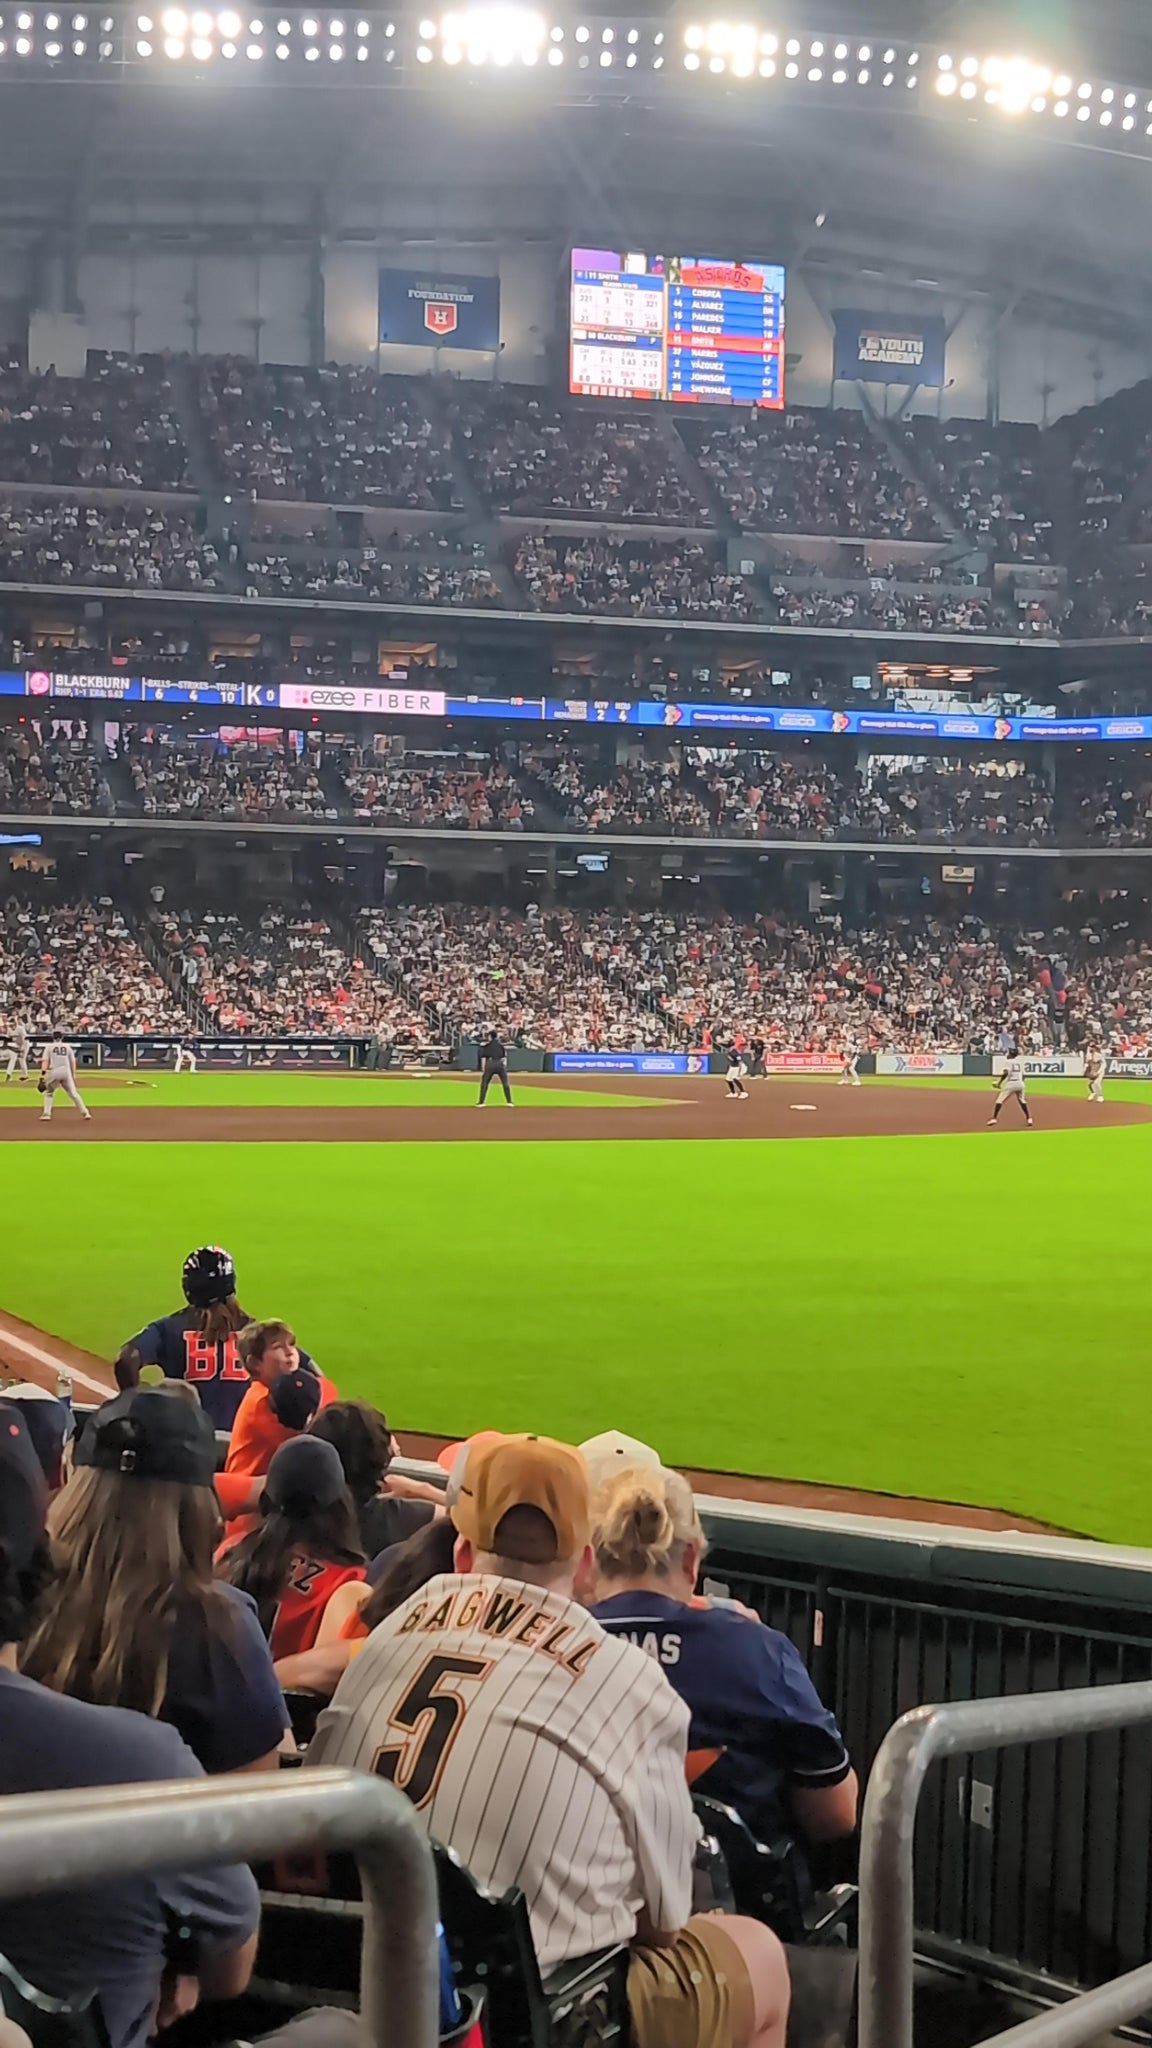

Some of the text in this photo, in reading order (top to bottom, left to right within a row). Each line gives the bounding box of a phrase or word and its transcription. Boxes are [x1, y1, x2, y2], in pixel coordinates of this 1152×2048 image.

[407, 289, 475, 303] FOUNDATION
[691, 288, 722, 298] CORREA
[691, 300, 724, 311] ALVAREZ
[691, 312, 725, 323] PAREDES
[691, 325, 722, 335] WALKER
[691, 336, 715, 346] SMITH
[880, 338, 923, 353] YOUTH
[858, 349, 923, 365] ACADEMY
[690, 372, 726, 383] JOHNSON
[55, 674, 130, 690] BLACKBURN
[155, 689, 235, 703] 6 4 10
[247, 684, 262, 706] K
[311, 690, 430, 710] ezee FIBER
[53, 1046, 67, 1056] 48
[1108, 1060, 1151, 1076] Amegy
[394, 1586, 601, 1680] BAGWELL
[370, 1650, 496, 1812] 5
